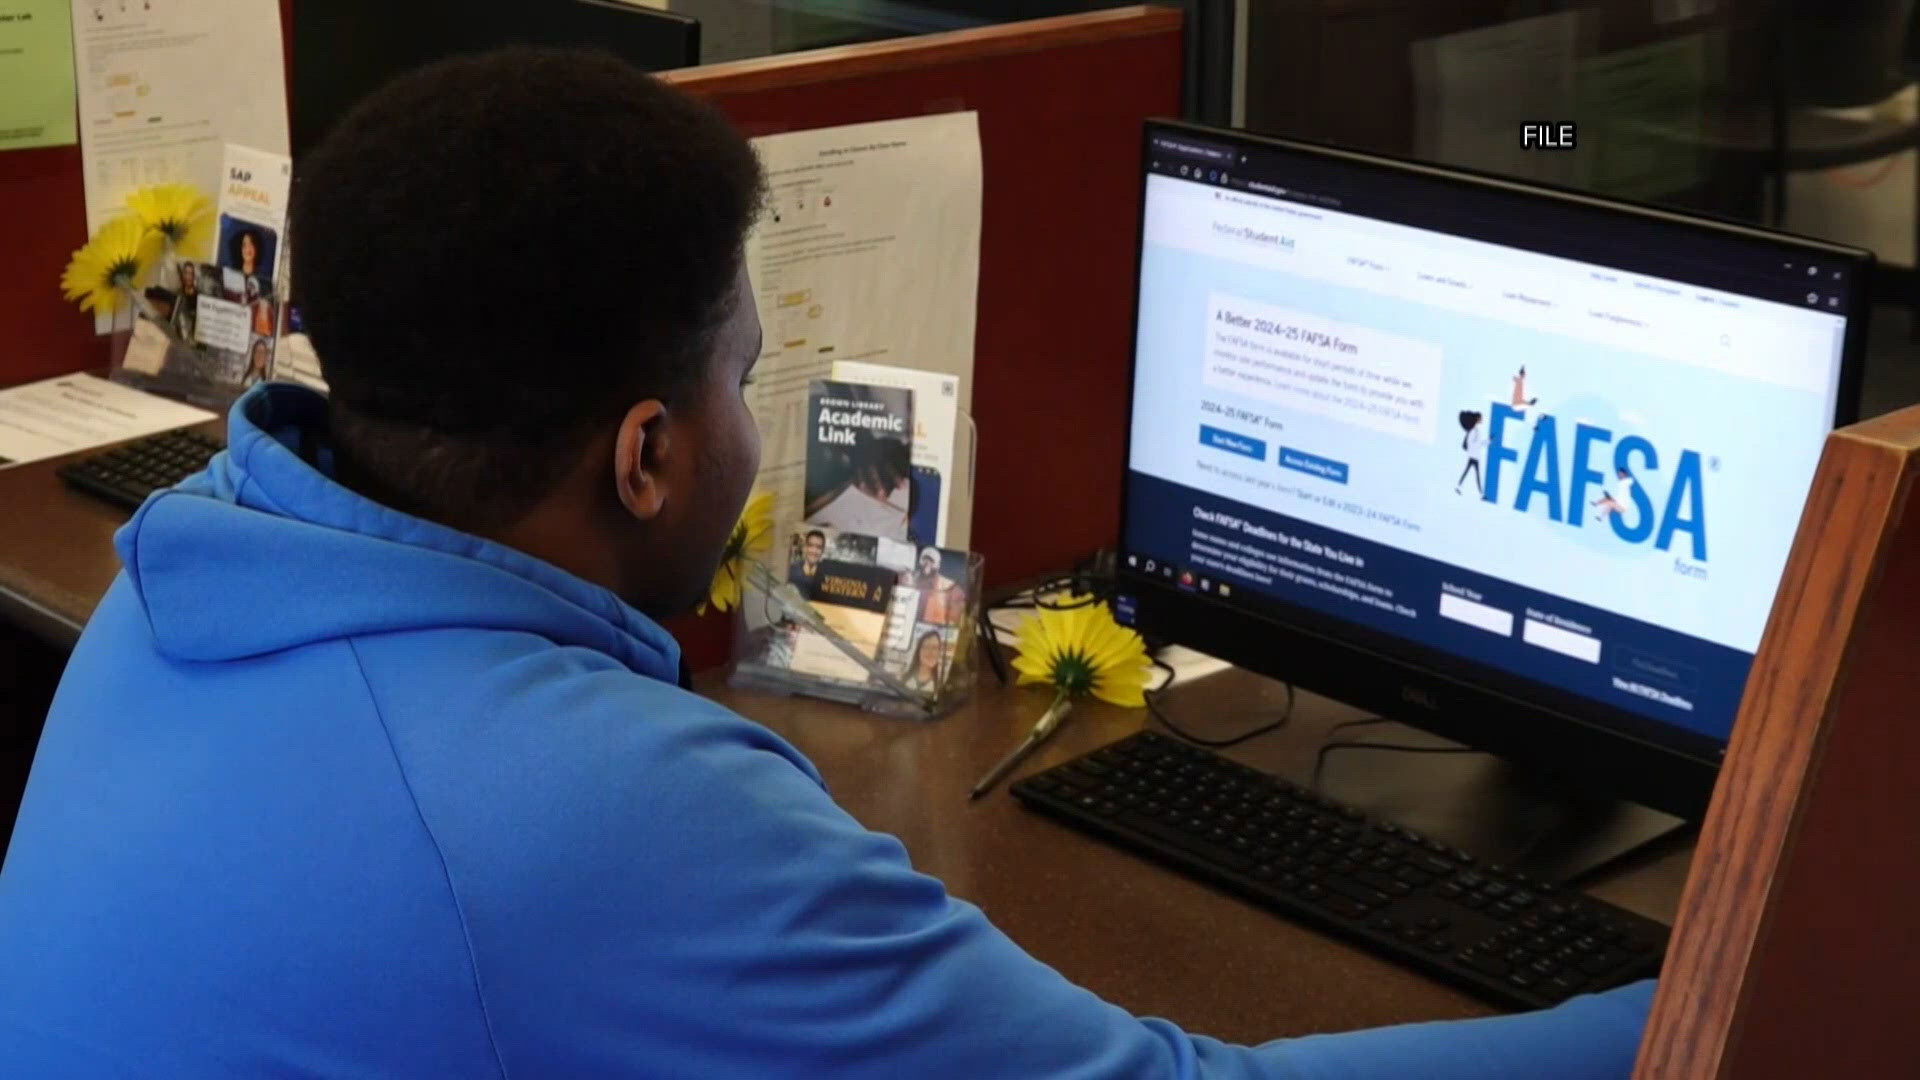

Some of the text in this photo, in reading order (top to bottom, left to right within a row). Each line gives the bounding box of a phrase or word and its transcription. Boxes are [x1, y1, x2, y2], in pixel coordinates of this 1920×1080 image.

[230, 167, 251, 182] SAP
[228, 184, 271, 207] APPEAL
[1244, 226, 1278, 245] Student
[1279, 235, 1295, 248] Aid
[1216, 310, 1223, 321] A
[1224, 311, 1252, 329] Better
[1301, 329, 1331, 349] FAFSA
[1333, 337, 1358, 355] Form
[820, 397, 886, 411] BROWN LIBRARY
[818, 407, 903, 432] Academic
[1264, 416, 1283, 431] Form
[818, 425, 856, 446] Link
[1483, 401, 1708, 563] FAFSA
[1193, 505, 1214, 523] Check
[1242, 521, 1277, 543] Deadlines
[1278, 531, 1290, 545] for
[1290, 535, 1303, 549] the
[1303, 538, 1323, 556] State
[1323, 545, 1338, 561] You
[1338, 548, 1355, 565] Live
[1673, 557, 1708, 582] form
[1395, 602, 1417, 619] Check
